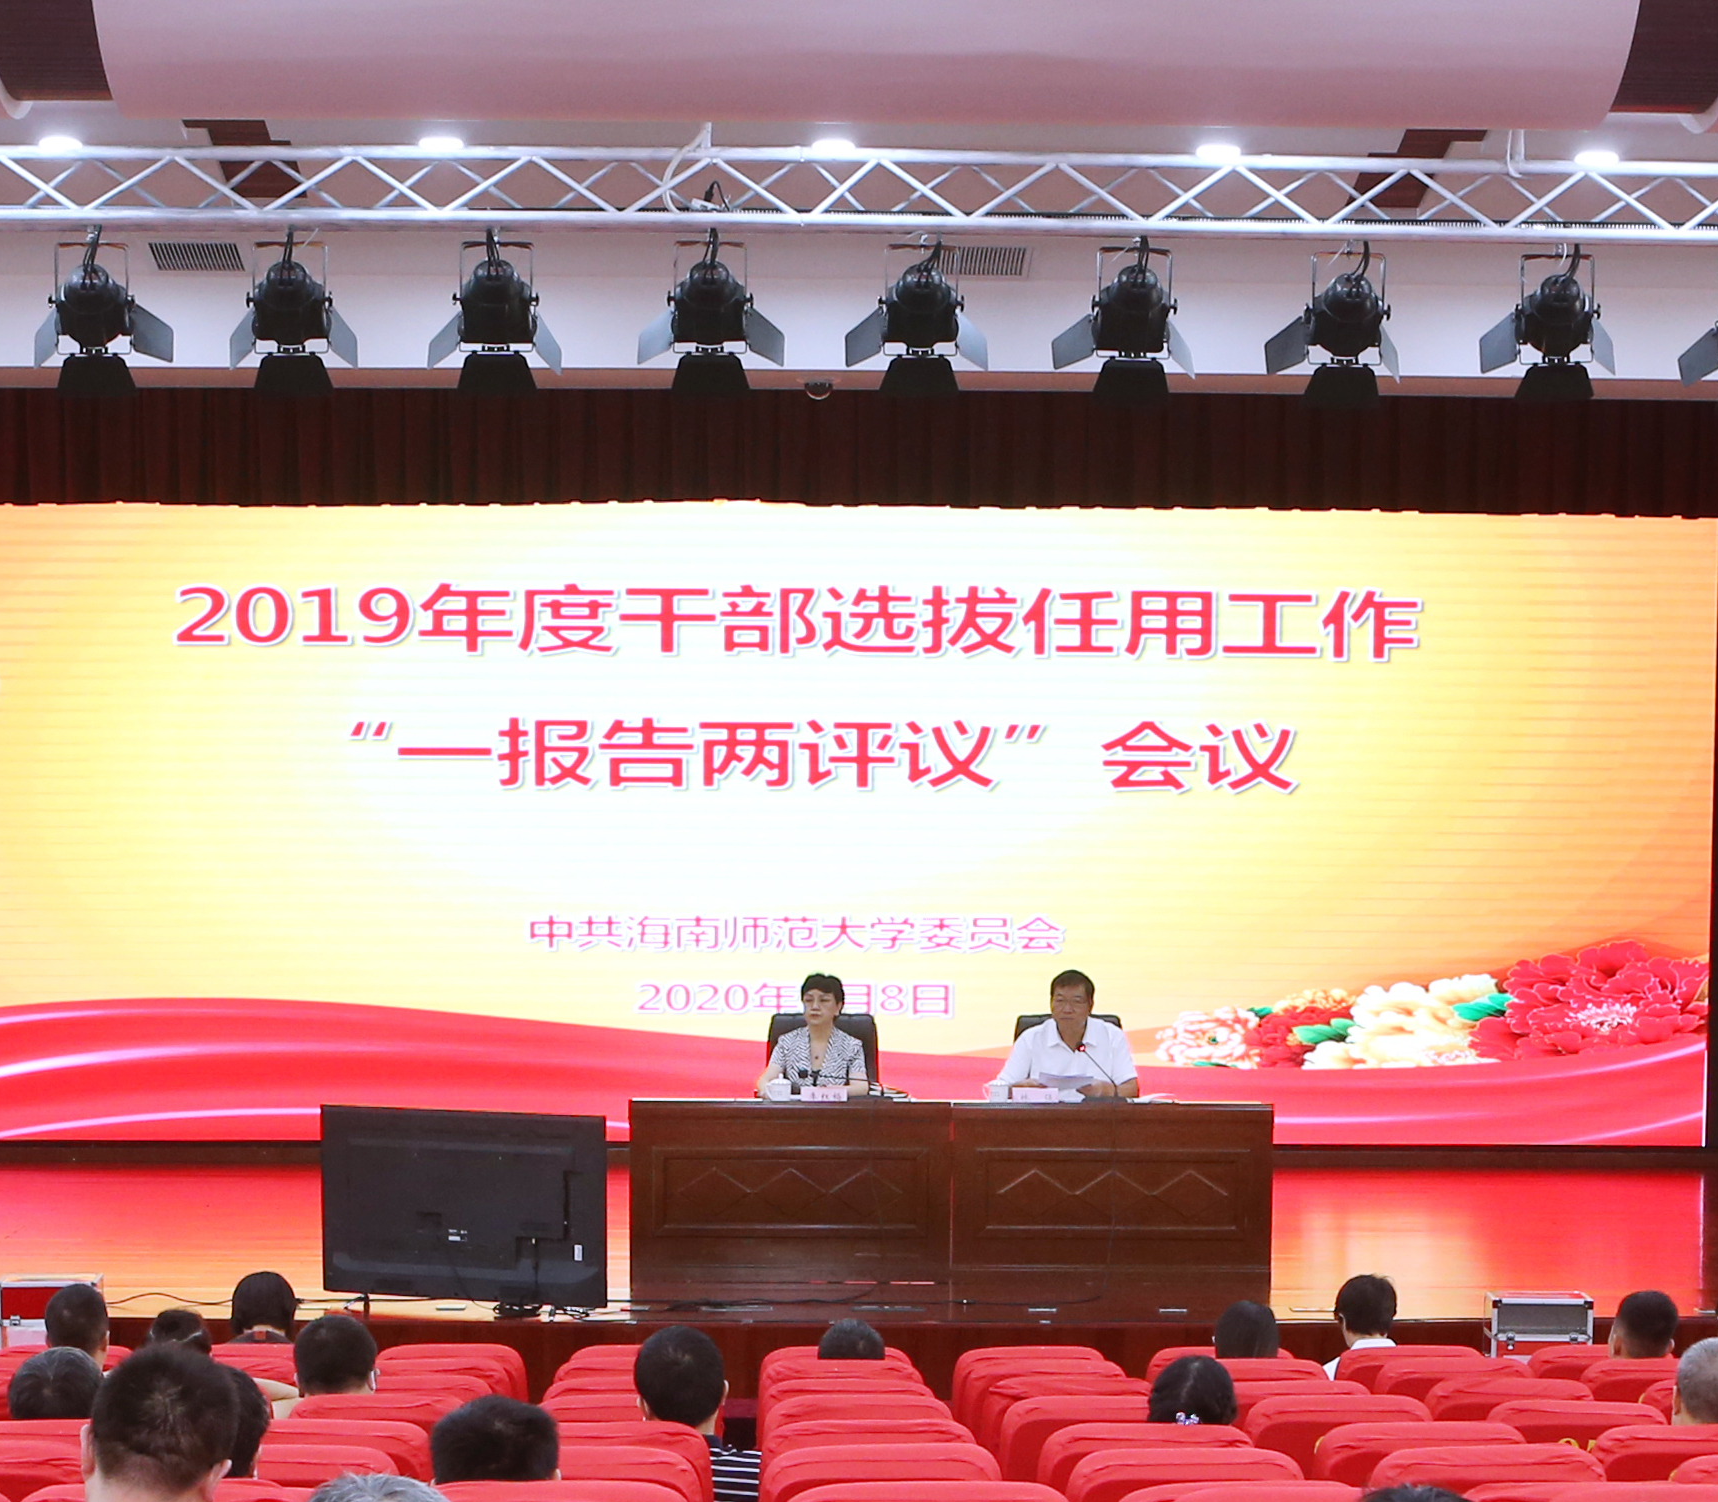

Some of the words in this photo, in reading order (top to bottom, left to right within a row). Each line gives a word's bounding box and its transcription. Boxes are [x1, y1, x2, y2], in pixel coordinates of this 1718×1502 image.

[173, 583, 1421, 660] 2019年度干部选拔任用工作
[528, 914, 1063, 952] 中共海南师范大学委员会
[635, 982, 955, 1017] 2020年月8日
